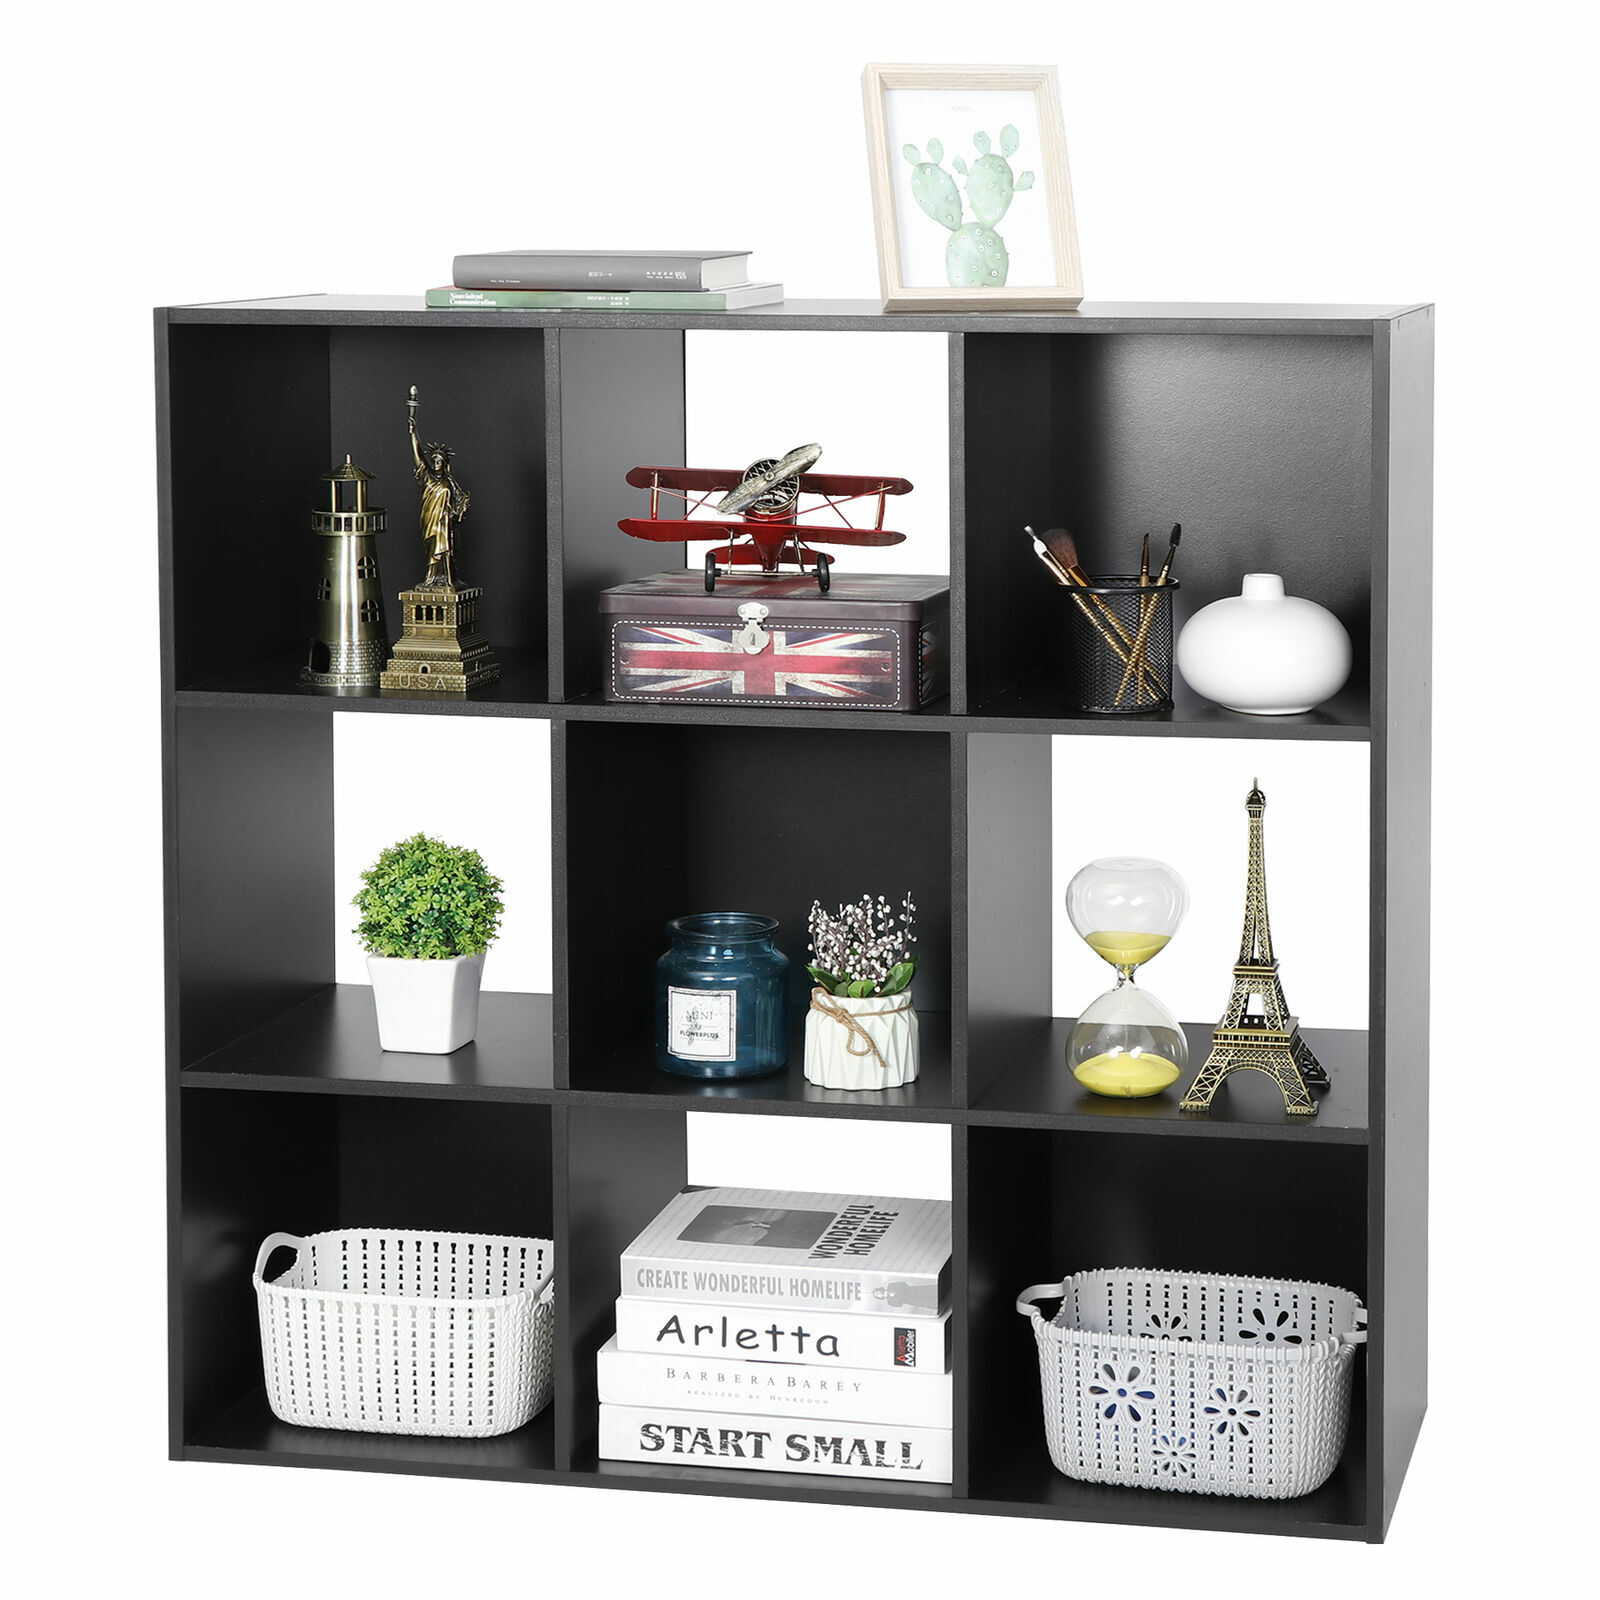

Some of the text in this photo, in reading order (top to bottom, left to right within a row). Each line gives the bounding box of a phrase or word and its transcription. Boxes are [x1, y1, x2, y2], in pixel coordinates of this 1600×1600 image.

[808, 1204, 874, 1259] WONDERFUL
[842, 1210, 899, 1256] HOMELIFE
[637, 1268, 862, 1301] CREATE WONDERFUL HOMELIFE
[656, 1314, 839, 1358] Arletta
[666, 1367, 863, 1393] BARBERA BAREY
[640, 1423, 923, 1470] START SMALL
